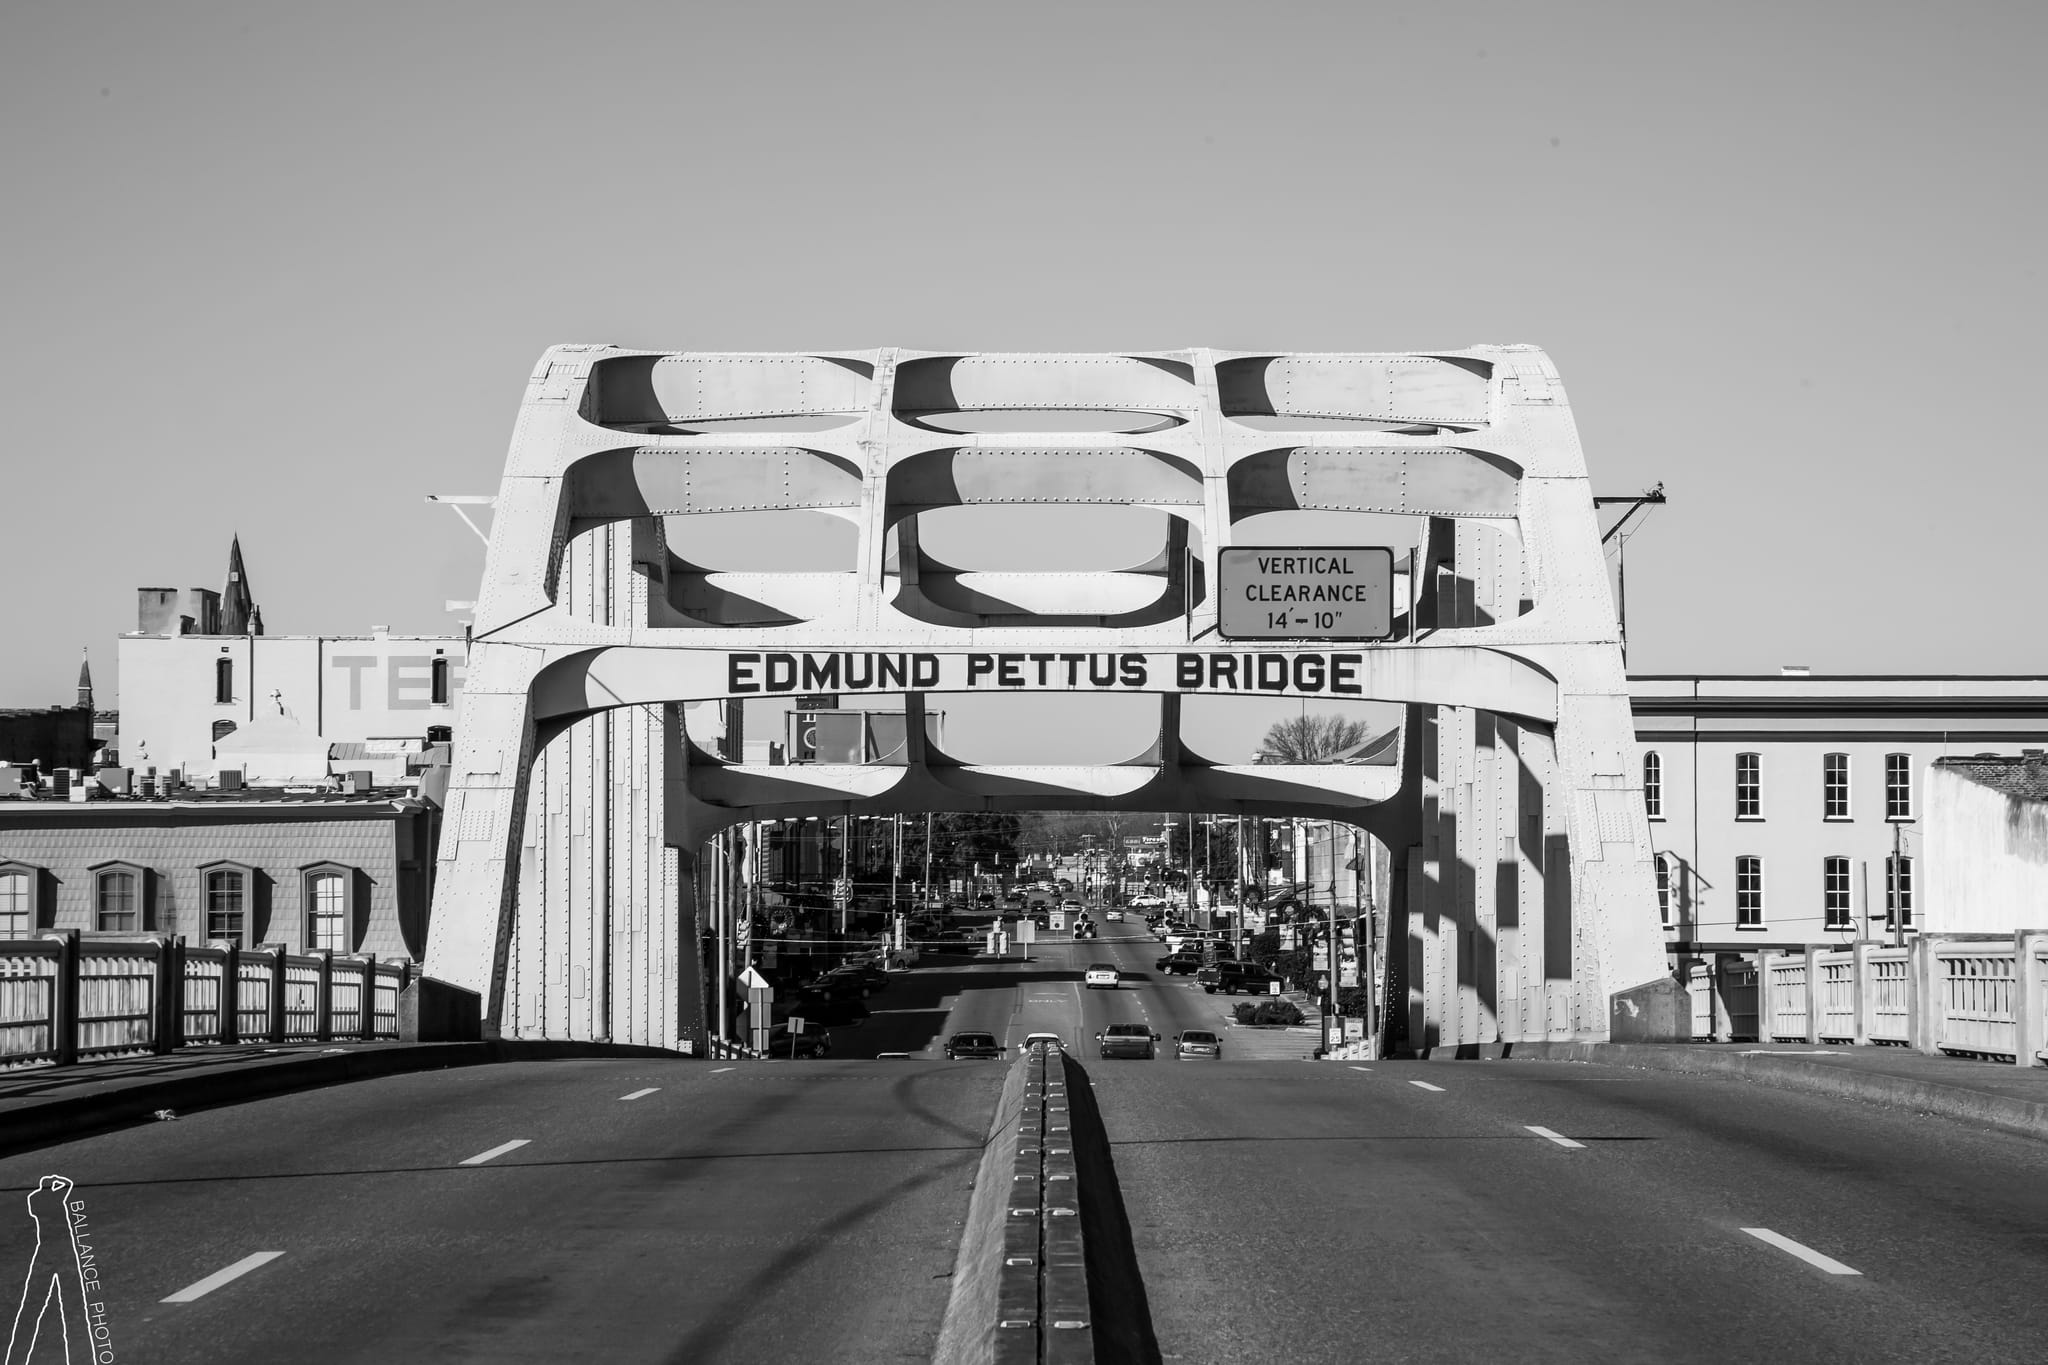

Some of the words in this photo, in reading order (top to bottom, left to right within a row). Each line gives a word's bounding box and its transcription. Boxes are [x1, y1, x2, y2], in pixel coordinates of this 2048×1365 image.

[1257, 557, 1354, 574] VERTICAL
[1245, 584, 1367, 602] CLEARANCE
[728, 652, 940, 693] EDMUND
[967, 653, 1148, 686] PETTUS
[1176, 653, 1363, 694] BRIDGE
